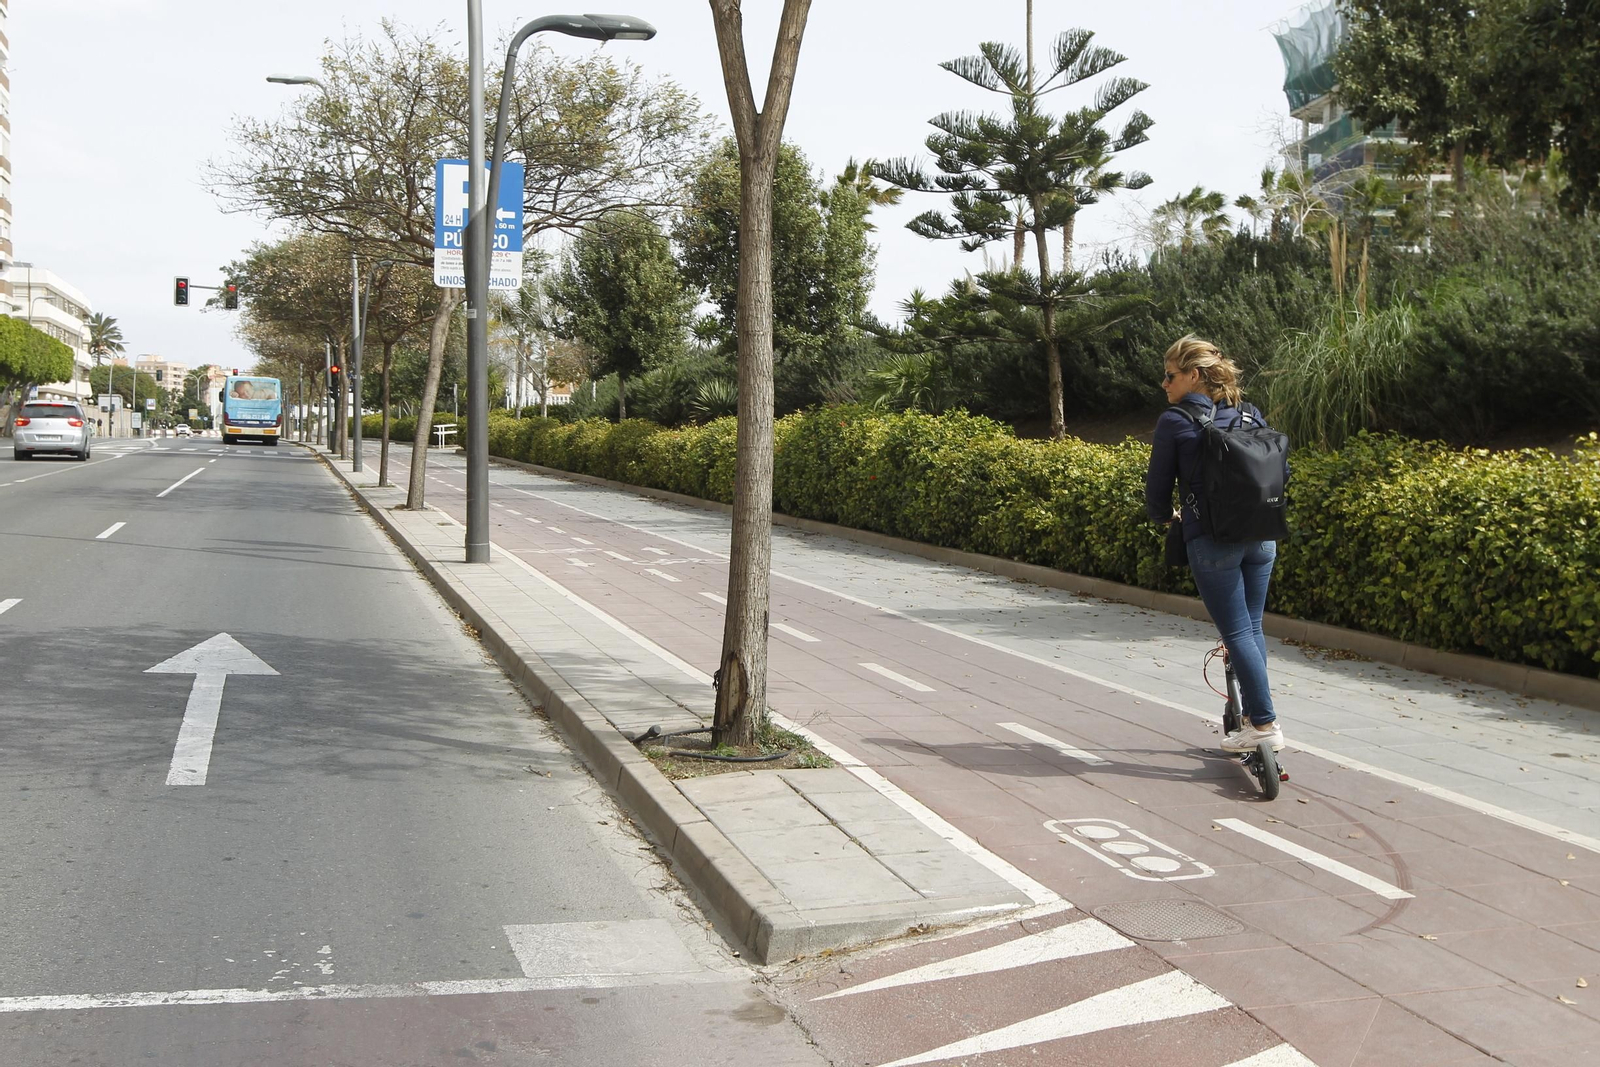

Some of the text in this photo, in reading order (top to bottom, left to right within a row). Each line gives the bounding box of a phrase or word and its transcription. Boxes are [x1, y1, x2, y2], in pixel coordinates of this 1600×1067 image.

[445, 214, 461, 225] 24 H
[440, 275, 465, 285] HNOS
